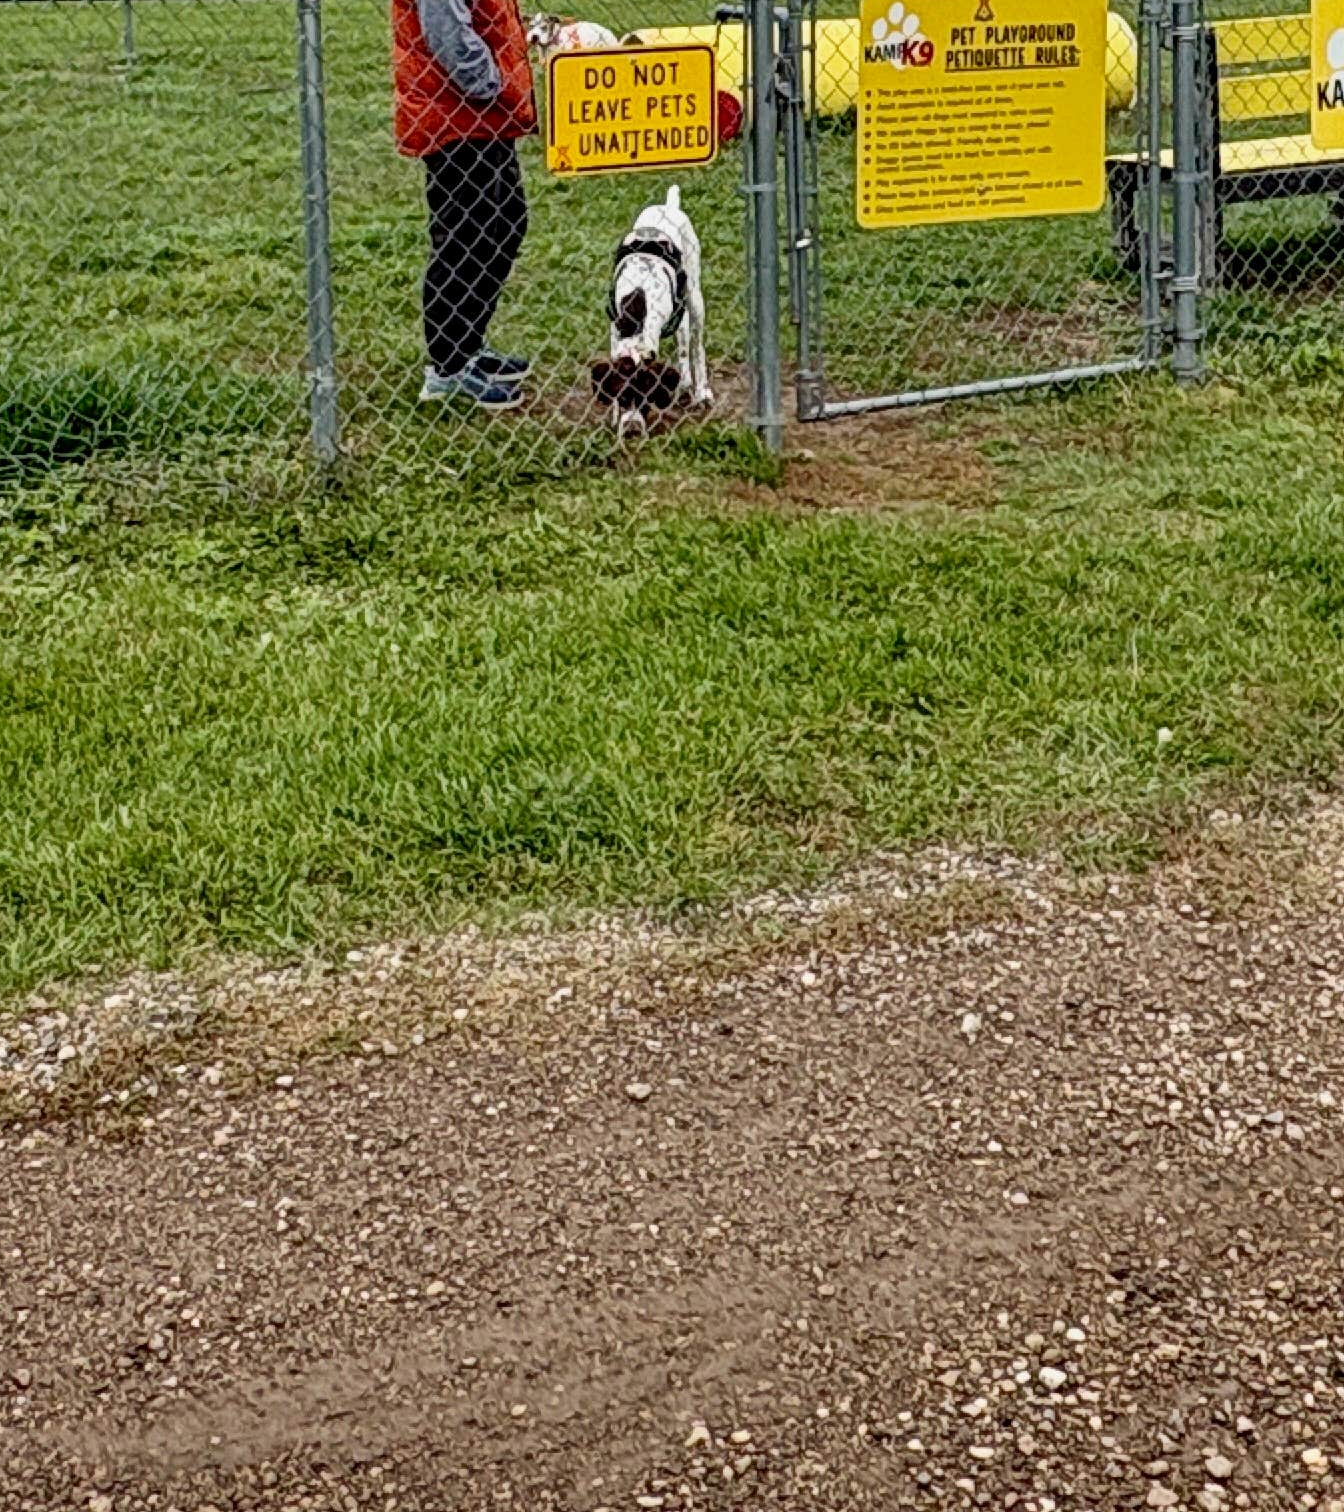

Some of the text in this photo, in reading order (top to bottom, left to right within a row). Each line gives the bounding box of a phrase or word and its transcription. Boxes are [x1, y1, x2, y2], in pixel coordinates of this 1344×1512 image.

[950, 23, 1076, 46] PET PLAYGROUND
[945, 47, 1026, 68] PETIQUETTE
[584, 62, 679, 90] DO NOT
[568, 93, 697, 125] LEAVE PETS
[579, 125, 709, 156] UNATTENDED
